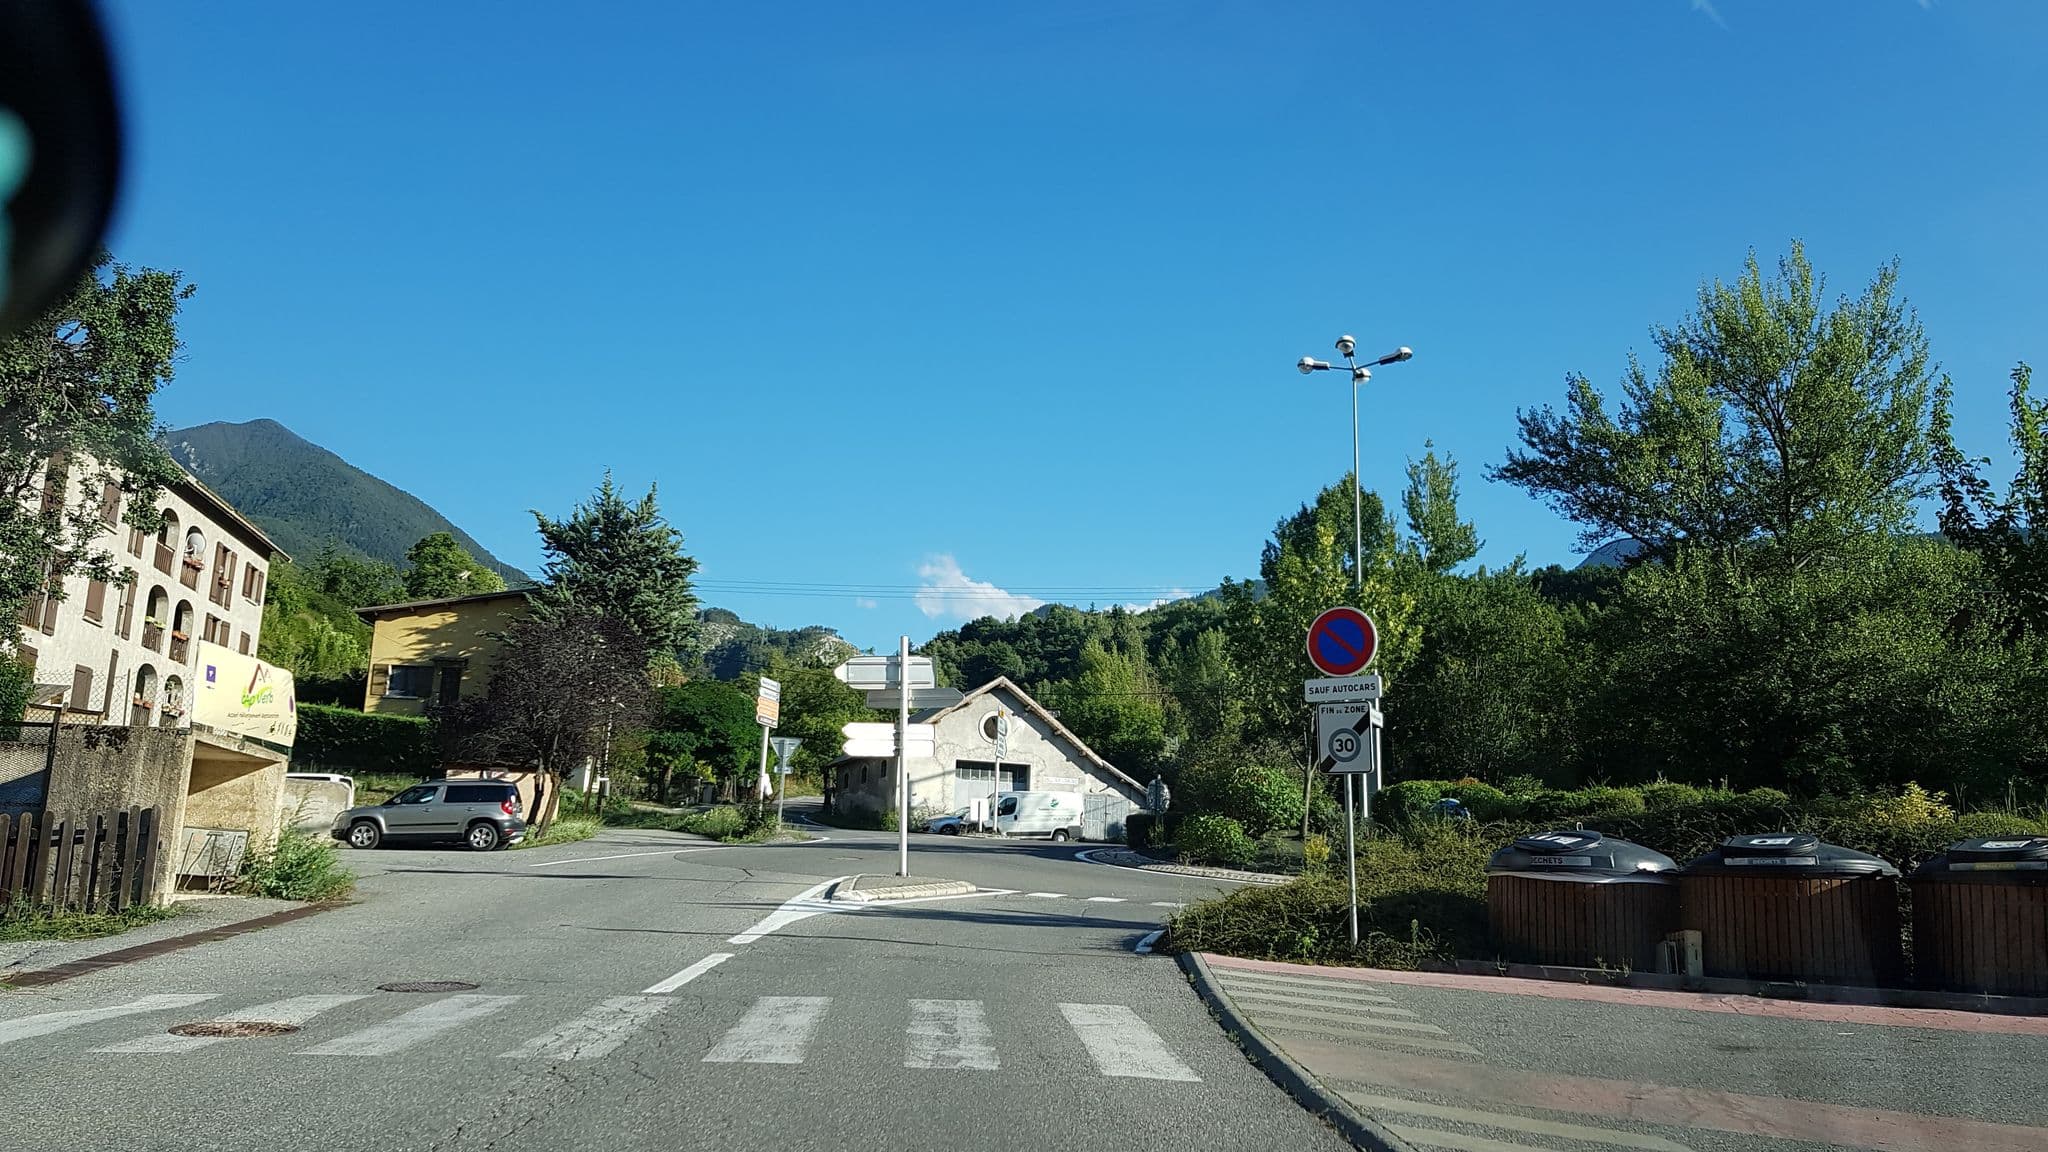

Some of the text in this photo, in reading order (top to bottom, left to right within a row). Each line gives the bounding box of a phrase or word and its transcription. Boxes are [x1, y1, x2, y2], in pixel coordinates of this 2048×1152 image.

[1309, 683, 1376, 695] SAUF AUTOCARS
[1321, 706, 1335, 714] FIN
[1344, 705, 1366, 714] ZONE
[1335, 738, 1355, 752] 30
